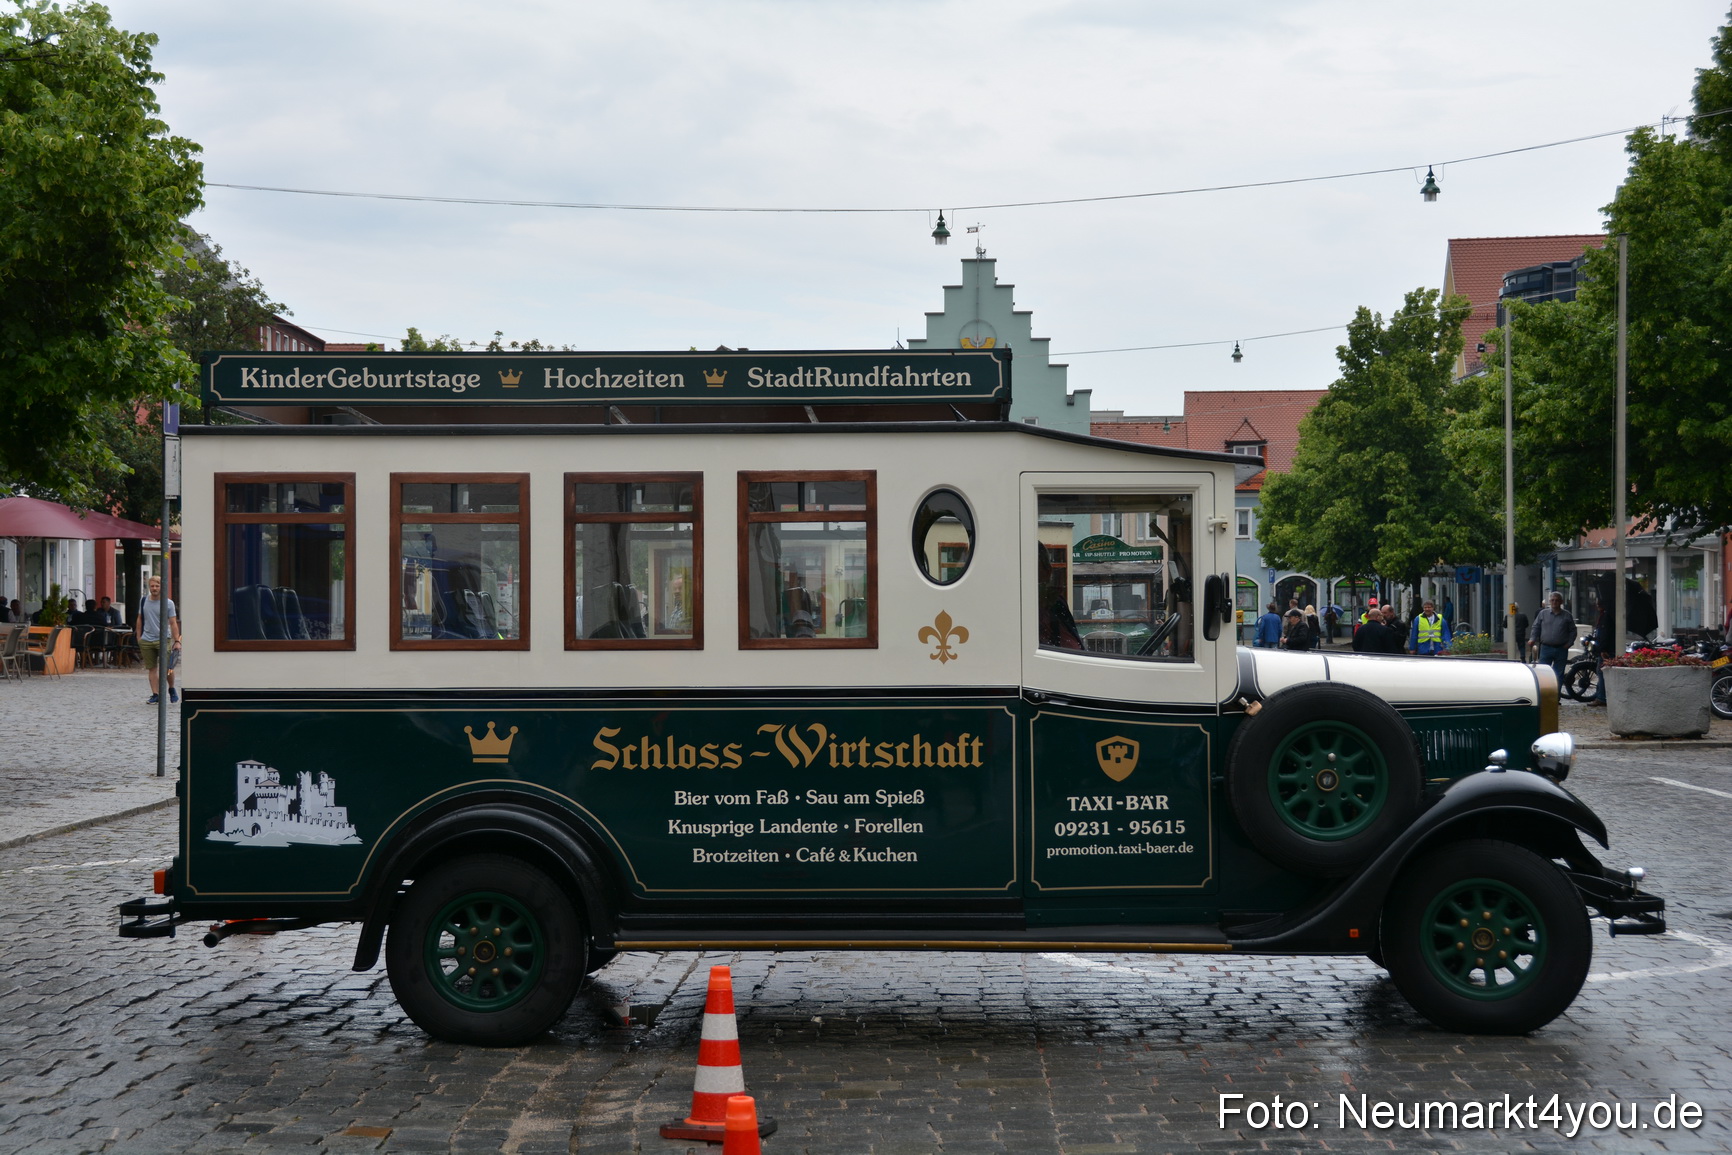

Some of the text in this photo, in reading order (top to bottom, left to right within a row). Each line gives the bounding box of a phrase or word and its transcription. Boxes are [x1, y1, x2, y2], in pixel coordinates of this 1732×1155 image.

[240, 366, 972, 393] KinderGeburtstage Hochzeiten StadtRundfahrten
[1082, 540, 1116, 551] Casino
[674, 789, 925, 807] Bier vom Faß Sau am Spieß
[668, 818, 924, 837] Knusprige Landente Forellen
[1054, 821, 1110, 836] 09231
[1129, 820, 1186, 834] 95615
[693, 848, 779, 863] Brotzeiten
[796, 847, 835, 862] Café
[854, 847, 918, 862] Kuchen
[1046, 842, 1194, 858] promotion.taxi-baer.de
